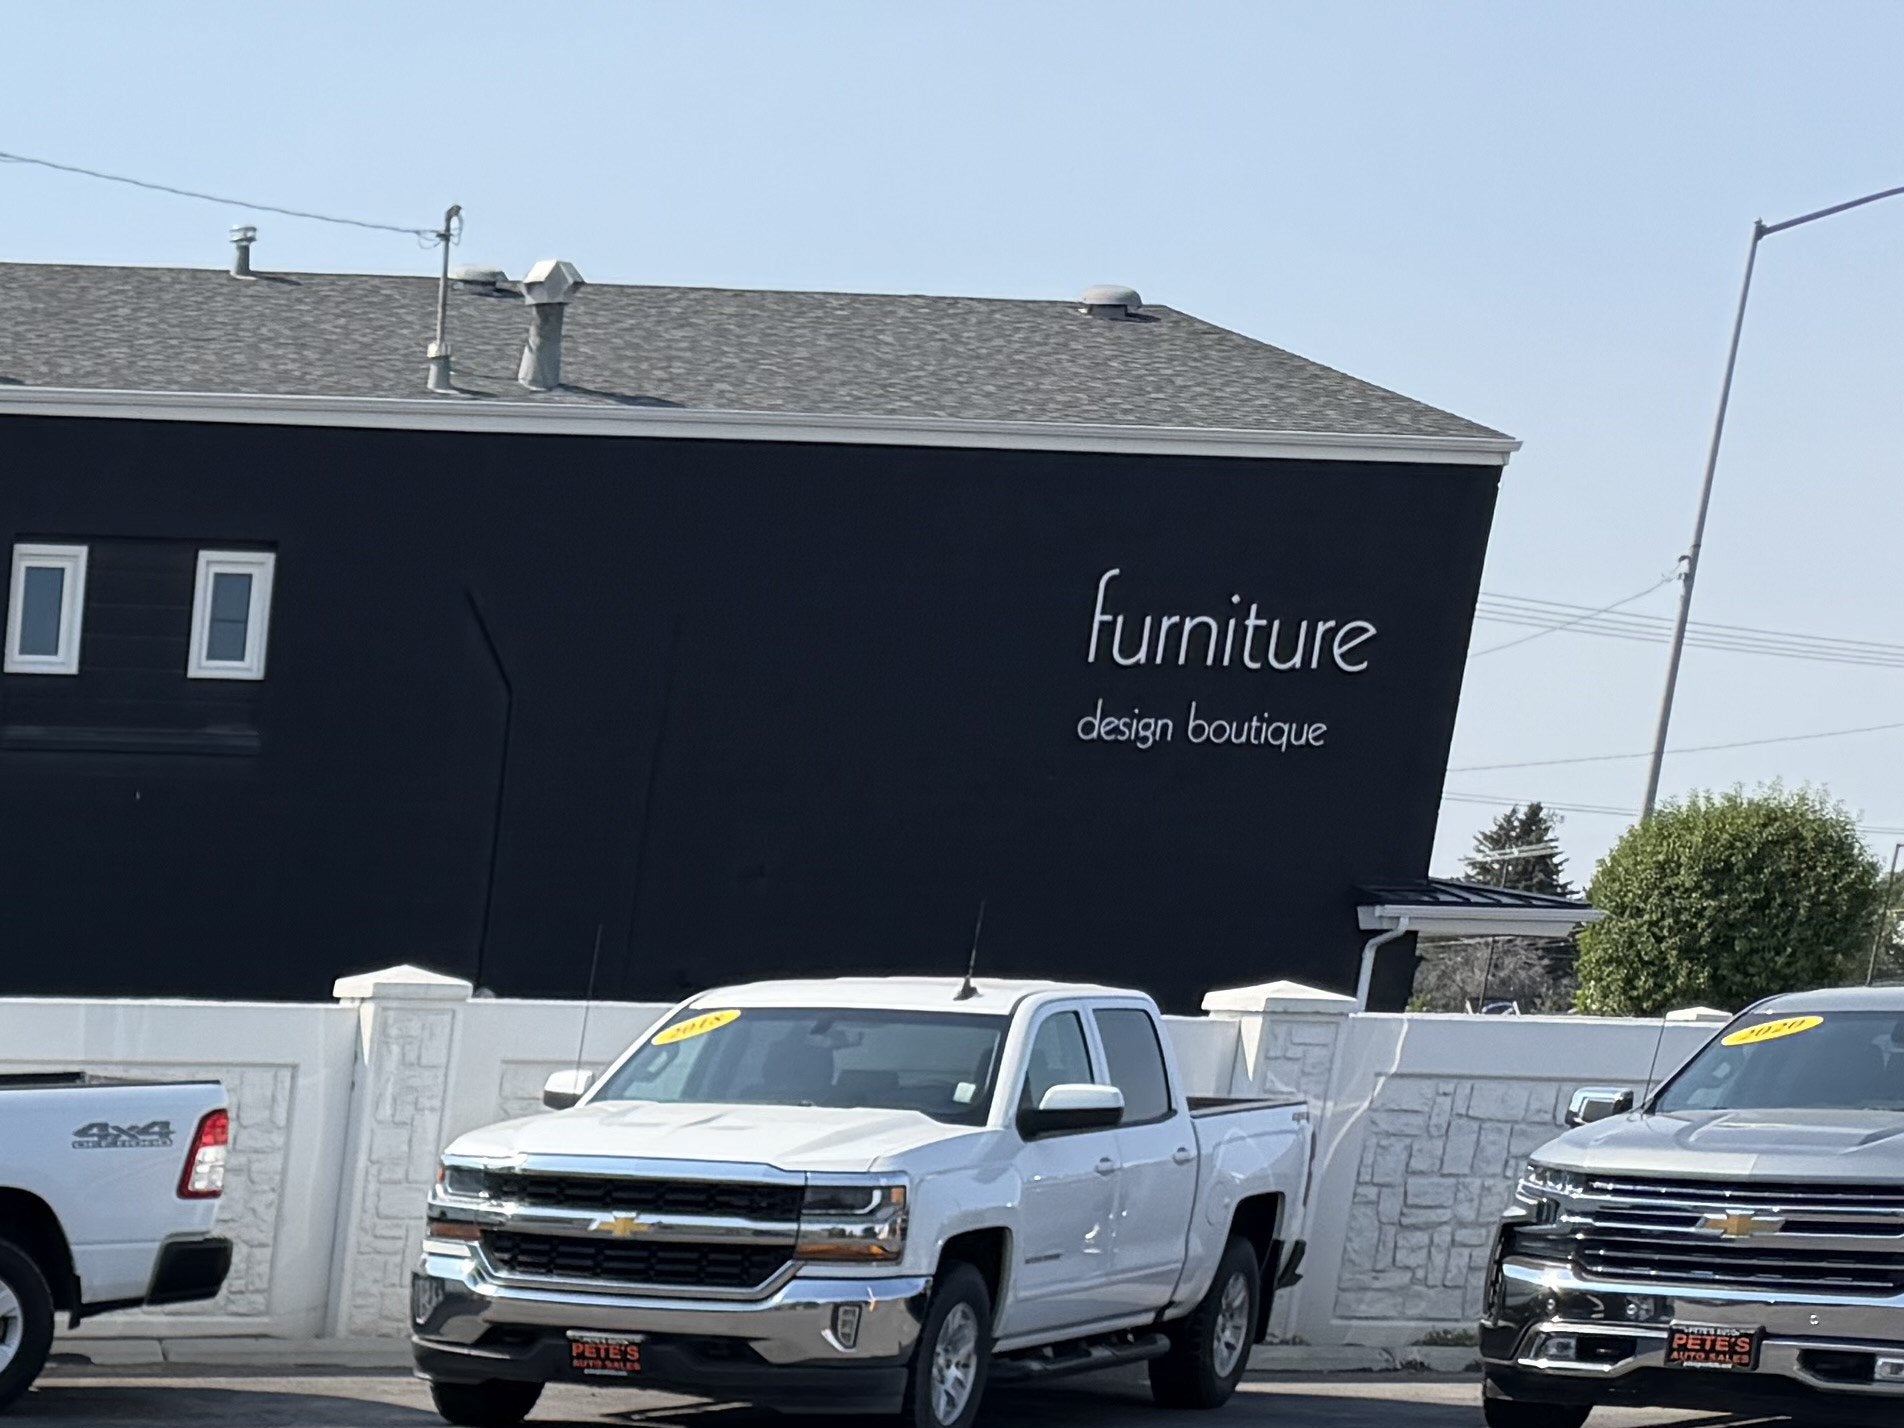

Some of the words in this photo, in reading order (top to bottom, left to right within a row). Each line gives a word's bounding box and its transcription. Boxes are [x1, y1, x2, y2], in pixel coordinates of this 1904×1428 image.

[1087, 568, 1377, 672] furniture
[1077, 698, 1173, 749] design
[1187, 701, 1327, 751] boutique
[572, 1343, 639, 1360] PETE'S
[1672, 1333, 1750, 1352] PETE'S
